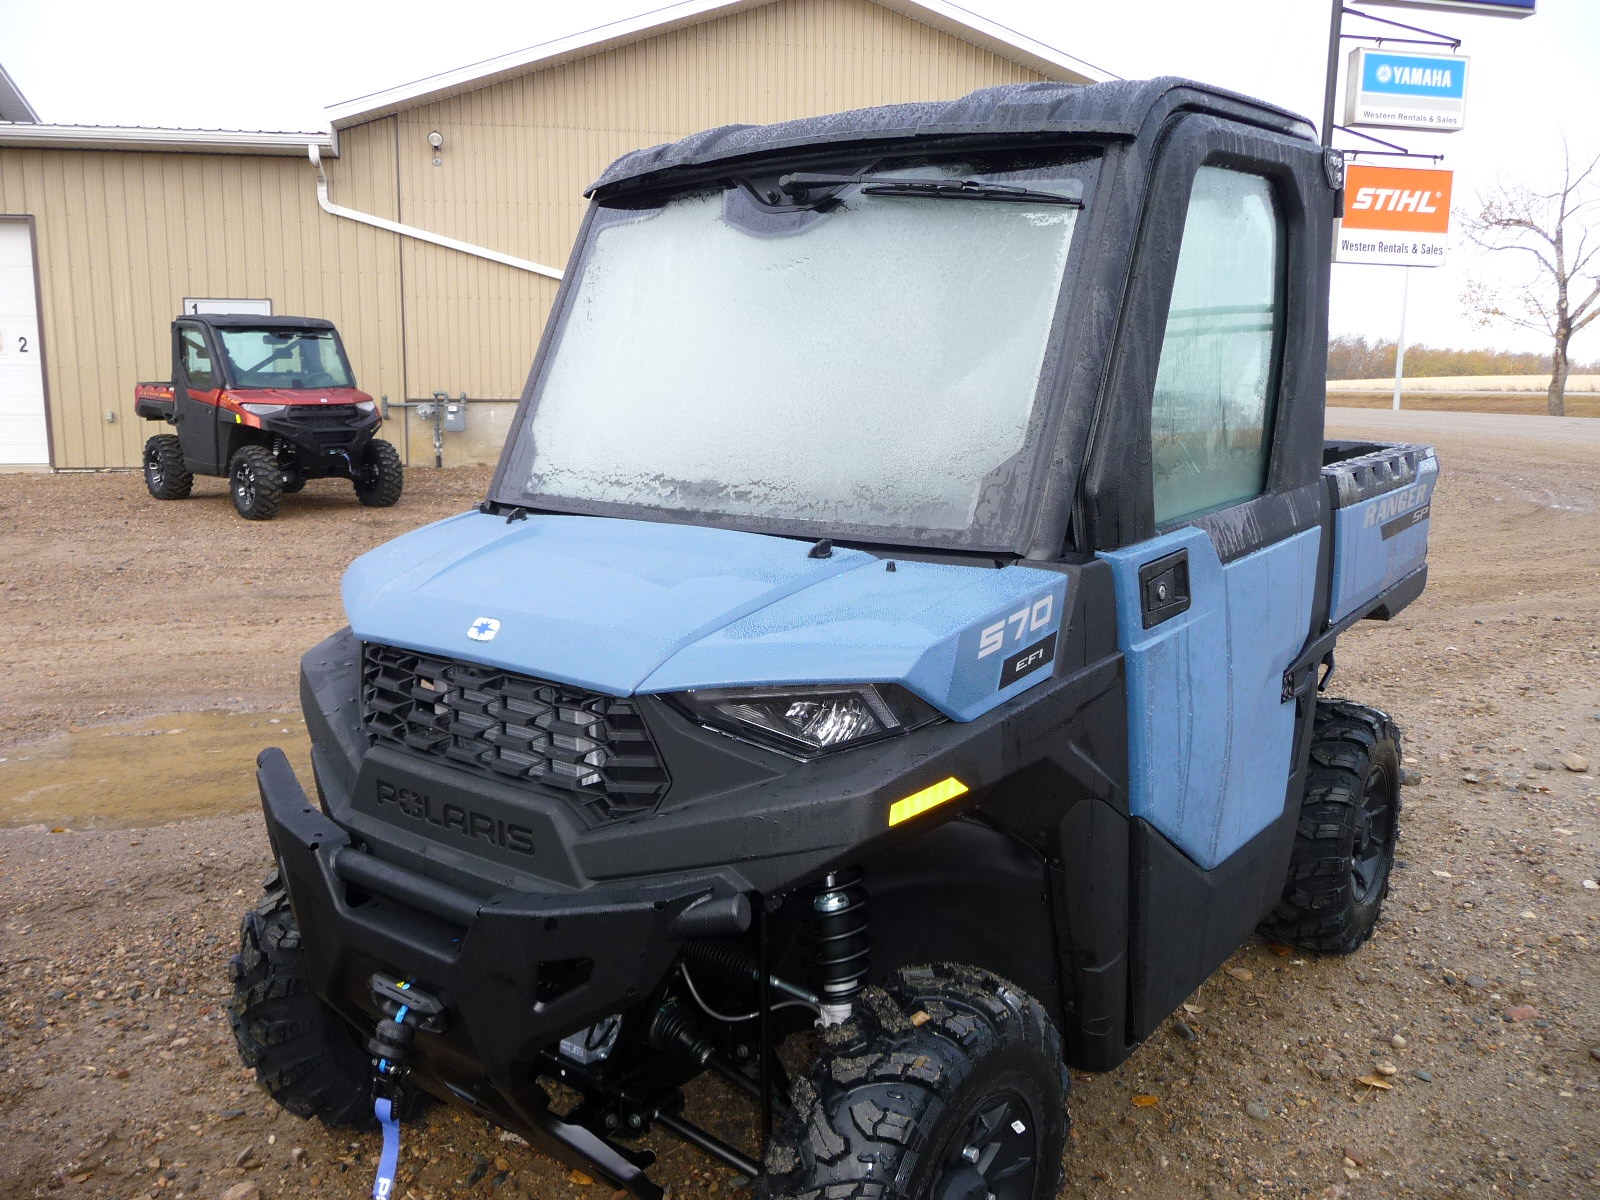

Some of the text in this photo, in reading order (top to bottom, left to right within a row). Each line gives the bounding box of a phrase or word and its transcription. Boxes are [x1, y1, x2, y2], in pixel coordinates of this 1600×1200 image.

[1393, 66, 1452, 88] YAMAHA
[1363, 110, 1458, 125] Western Rentals & Sales
[1341, 239, 1443, 256] Western Rentals & Sales
[18, 336, 29, 353] 2
[1363, 483, 1427, 529] RANGER
[1411, 506, 1429, 523] SP
[977, 594, 1053, 660] 570
[1015, 648, 1044, 672] EFI
[376, 778, 535, 856] POLARIS
